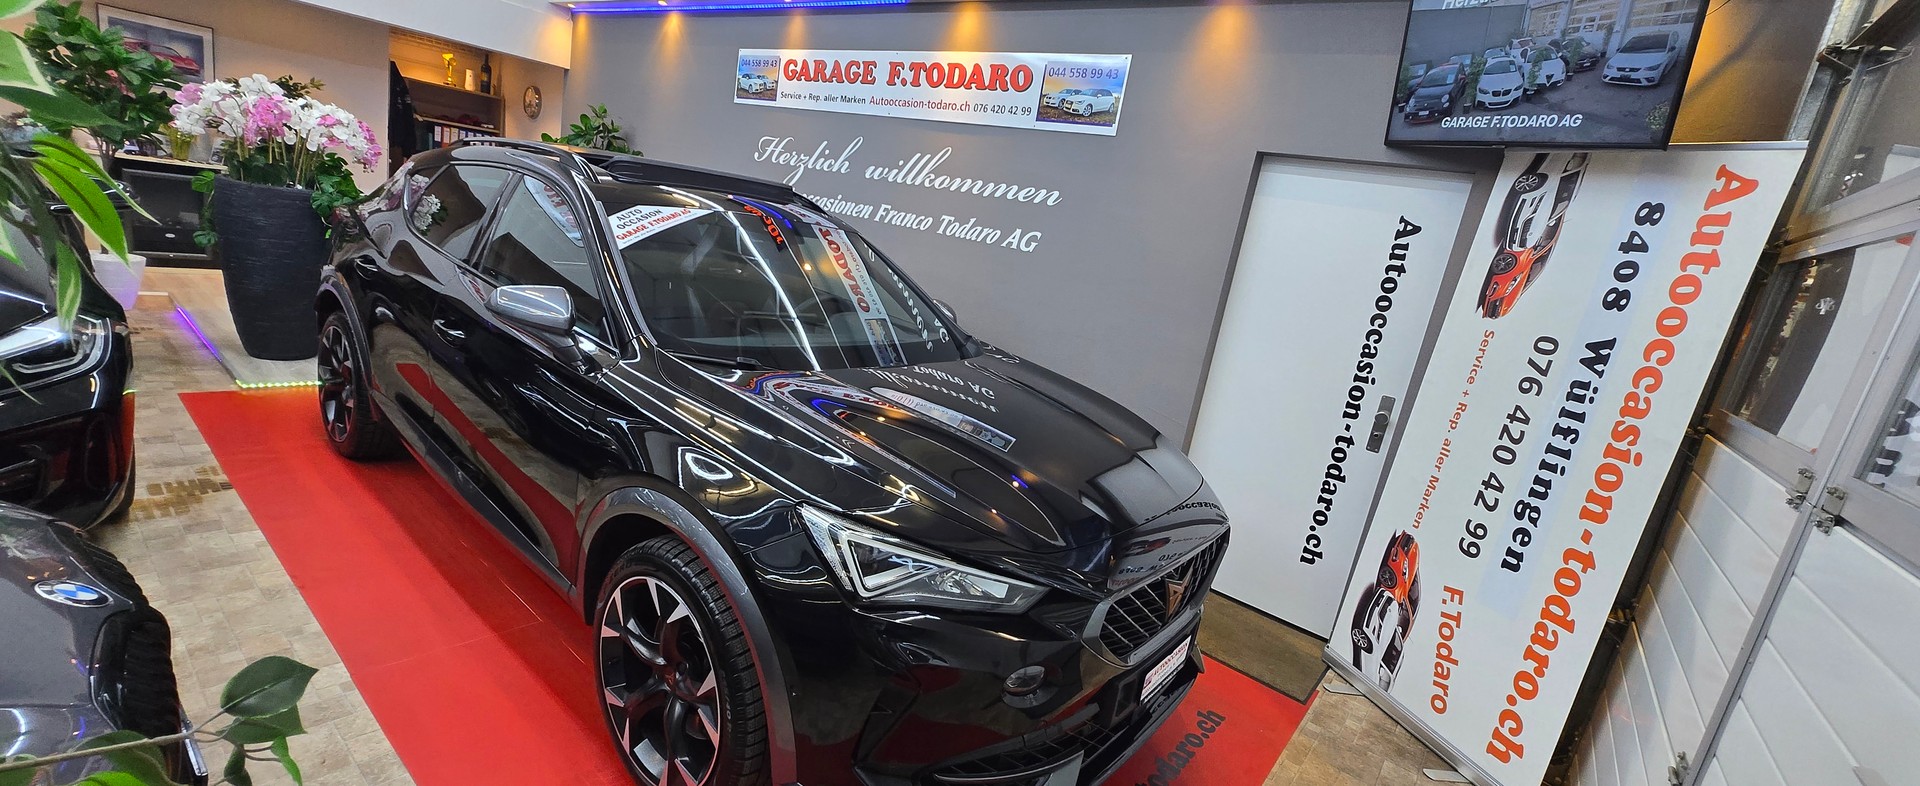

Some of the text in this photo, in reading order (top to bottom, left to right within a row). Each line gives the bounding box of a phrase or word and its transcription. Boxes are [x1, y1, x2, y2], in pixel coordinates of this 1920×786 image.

[783, 59, 1034, 92] GARAGE F.TODARO
[1048, 67, 1120, 80] 044 558 99 43
[780, 91, 802, 100] Service
[808, 93, 822, 102] Rep.
[823, 93, 839, 102] aller
[840, 95, 866, 105] Marken
[869, 96, 970, 112] Autooccasion-todaro.ch
[973, 103, 988, 113] 076
[990, 104, 1006, 115] 420
[1008, 105, 1018, 115] 42
[1021, 106, 1032, 116] 99
[1441, 114, 1583, 128] GARAGE F.TODARO AG
[754, 135, 1063, 206] Herzlich willkommen
[616, 208, 643, 222] AUTO
[616, 209, 663, 230] OCCASION
[616, 224, 649, 240] GARAGE
[874, 203, 933, 231] Franco
[936, 214, 1001, 245] Todaro
[1001, 228, 1042, 253] AG
[1467, 329, 1495, 385] Service
[1300, 215, 1422, 566] Autooccasion-todaro.ch
[1500, 201, 1666, 573] 8408 Wülflingen
[1447, 401, 1468, 433] Rep.
[1434, 438, 1452, 472] aller
[1458, 335, 1560, 559] 076 420 42 99
[1485, 163, 1760, 765] Autooccasion-todaro.ch
[1412, 474, 1440, 530] Marken
[1430, 584, 1464, 715] F.Todaro
[1136, 710, 1226, 786] odaro.ch
